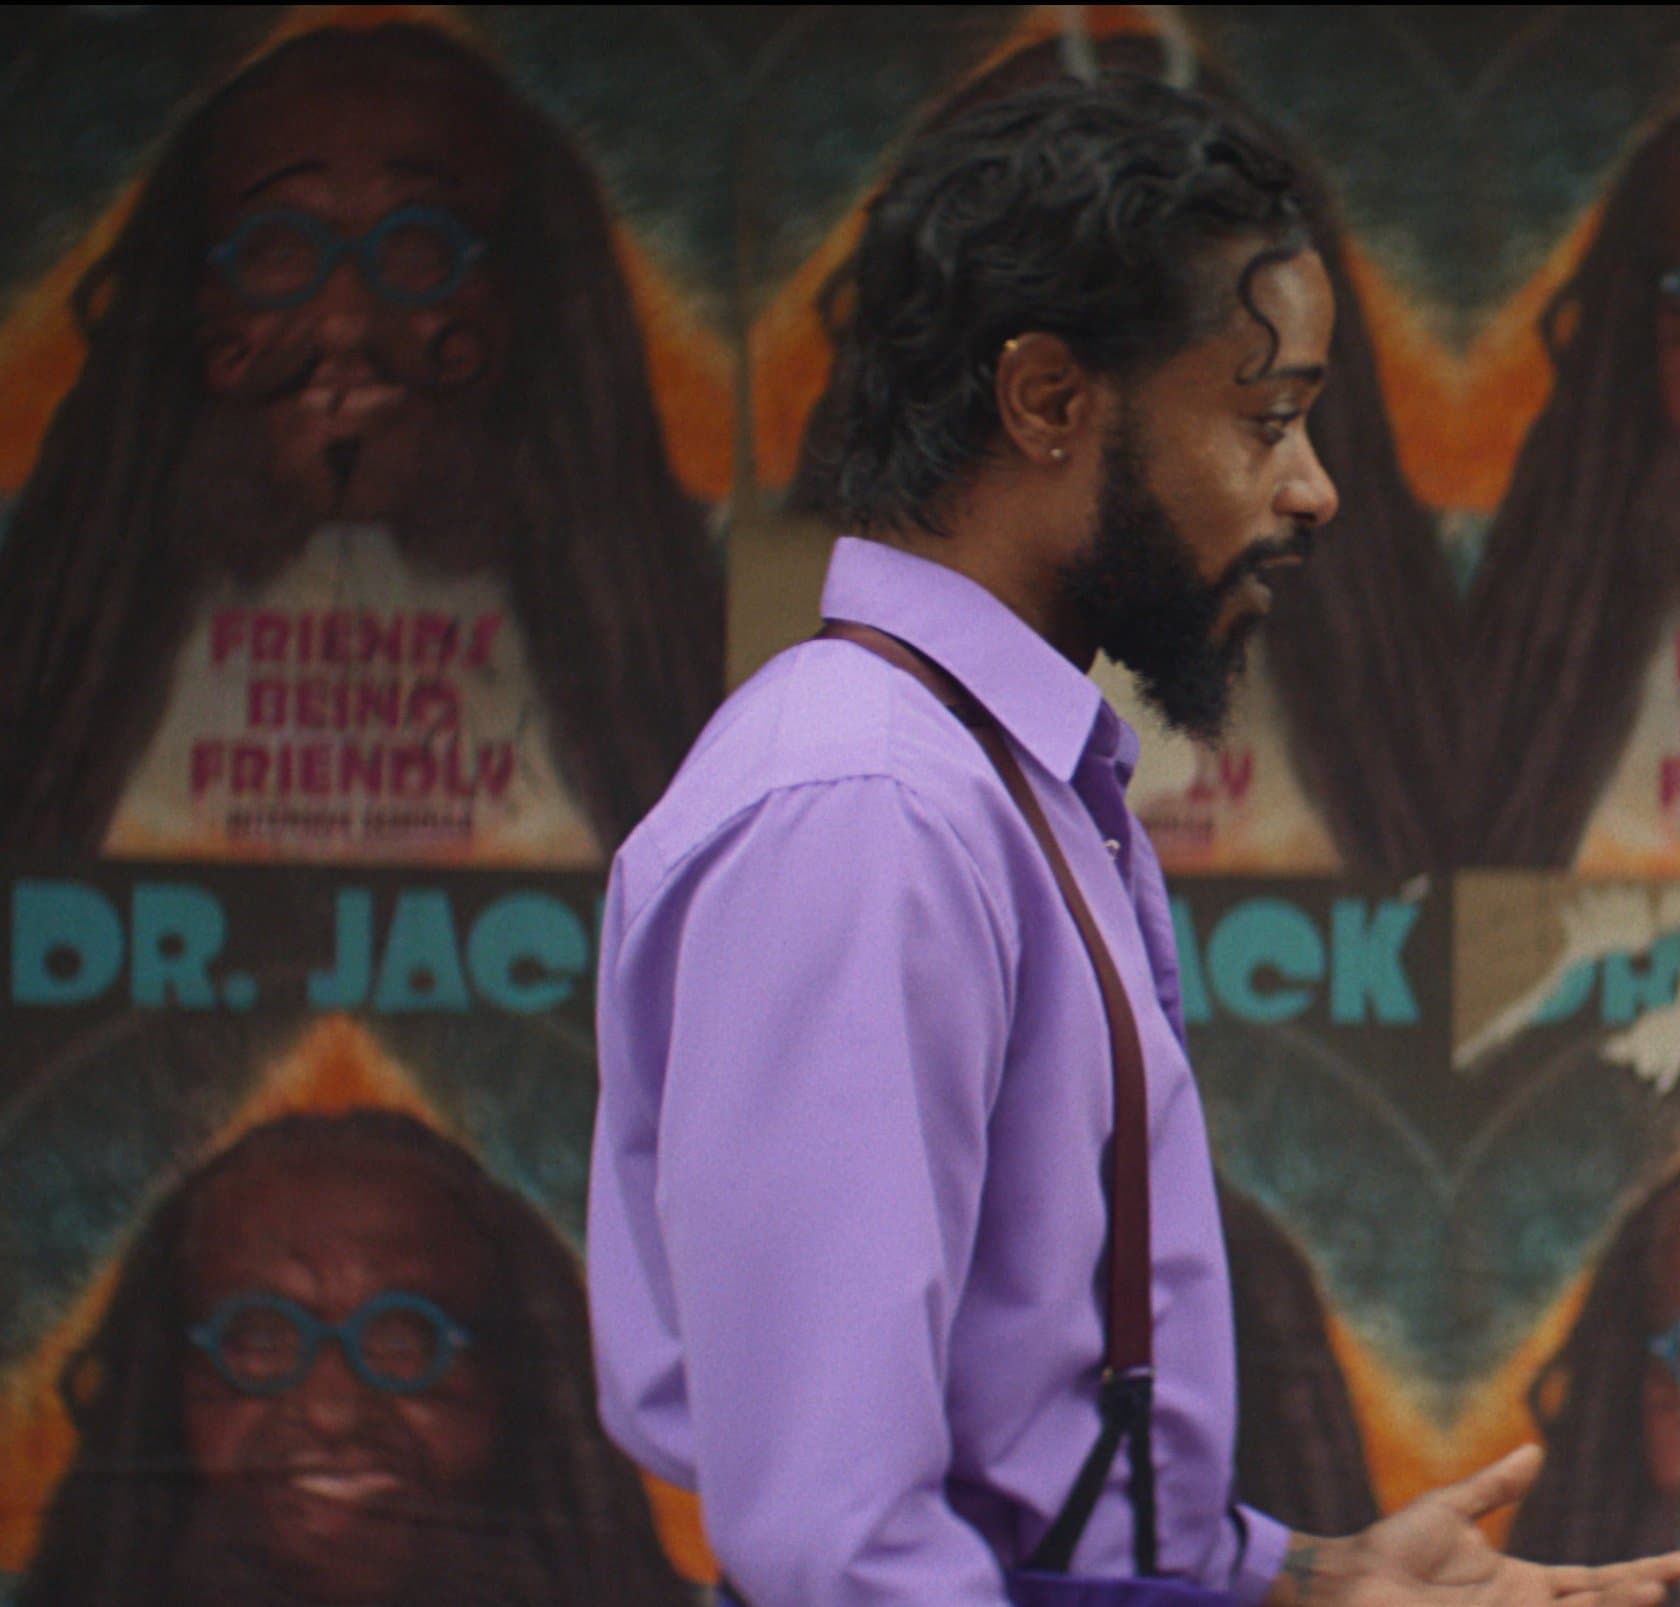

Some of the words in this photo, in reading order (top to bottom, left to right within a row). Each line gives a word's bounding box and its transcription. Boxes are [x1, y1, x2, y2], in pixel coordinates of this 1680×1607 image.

[208, 609, 505, 664] FRIENDS
[245, 677, 466, 734] BEING
[190, 742, 517, 796] FRIENDLY
[10, 879, 258, 1011] DR.
[306, 886, 606, 1014] JAC
